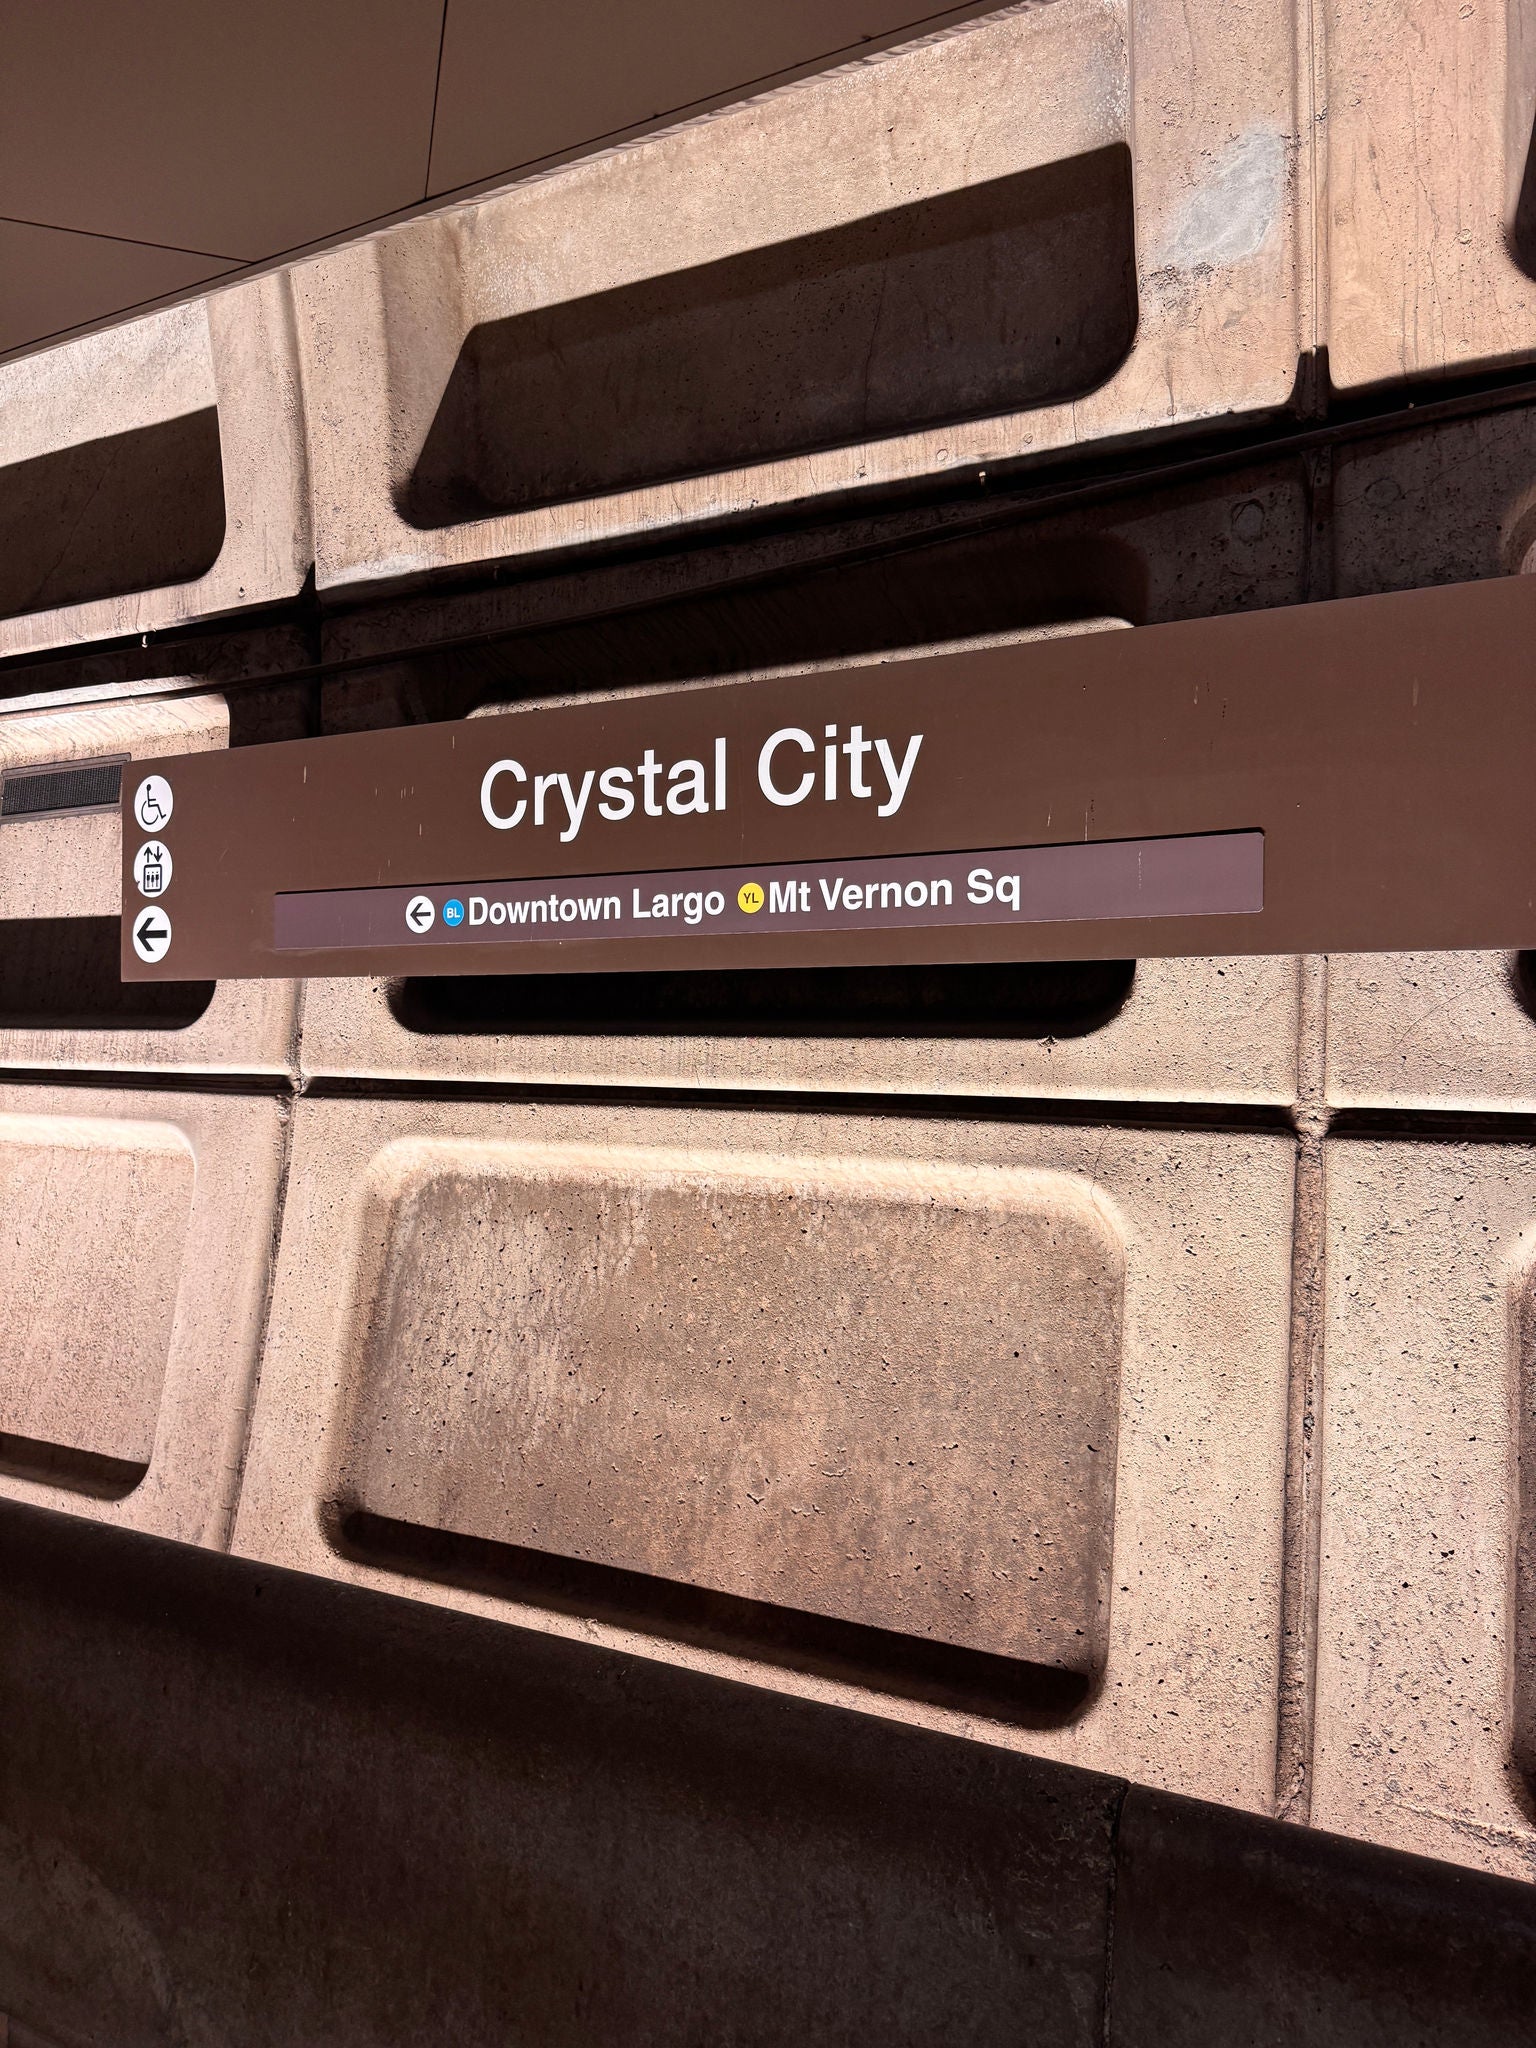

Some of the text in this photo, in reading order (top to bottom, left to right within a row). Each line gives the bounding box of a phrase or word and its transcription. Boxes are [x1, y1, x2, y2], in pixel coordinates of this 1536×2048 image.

[480, 723, 924, 843] Crystal City
[446, 868, 1021, 926] BL Downtown Largo YL Mt Vernon Sq
